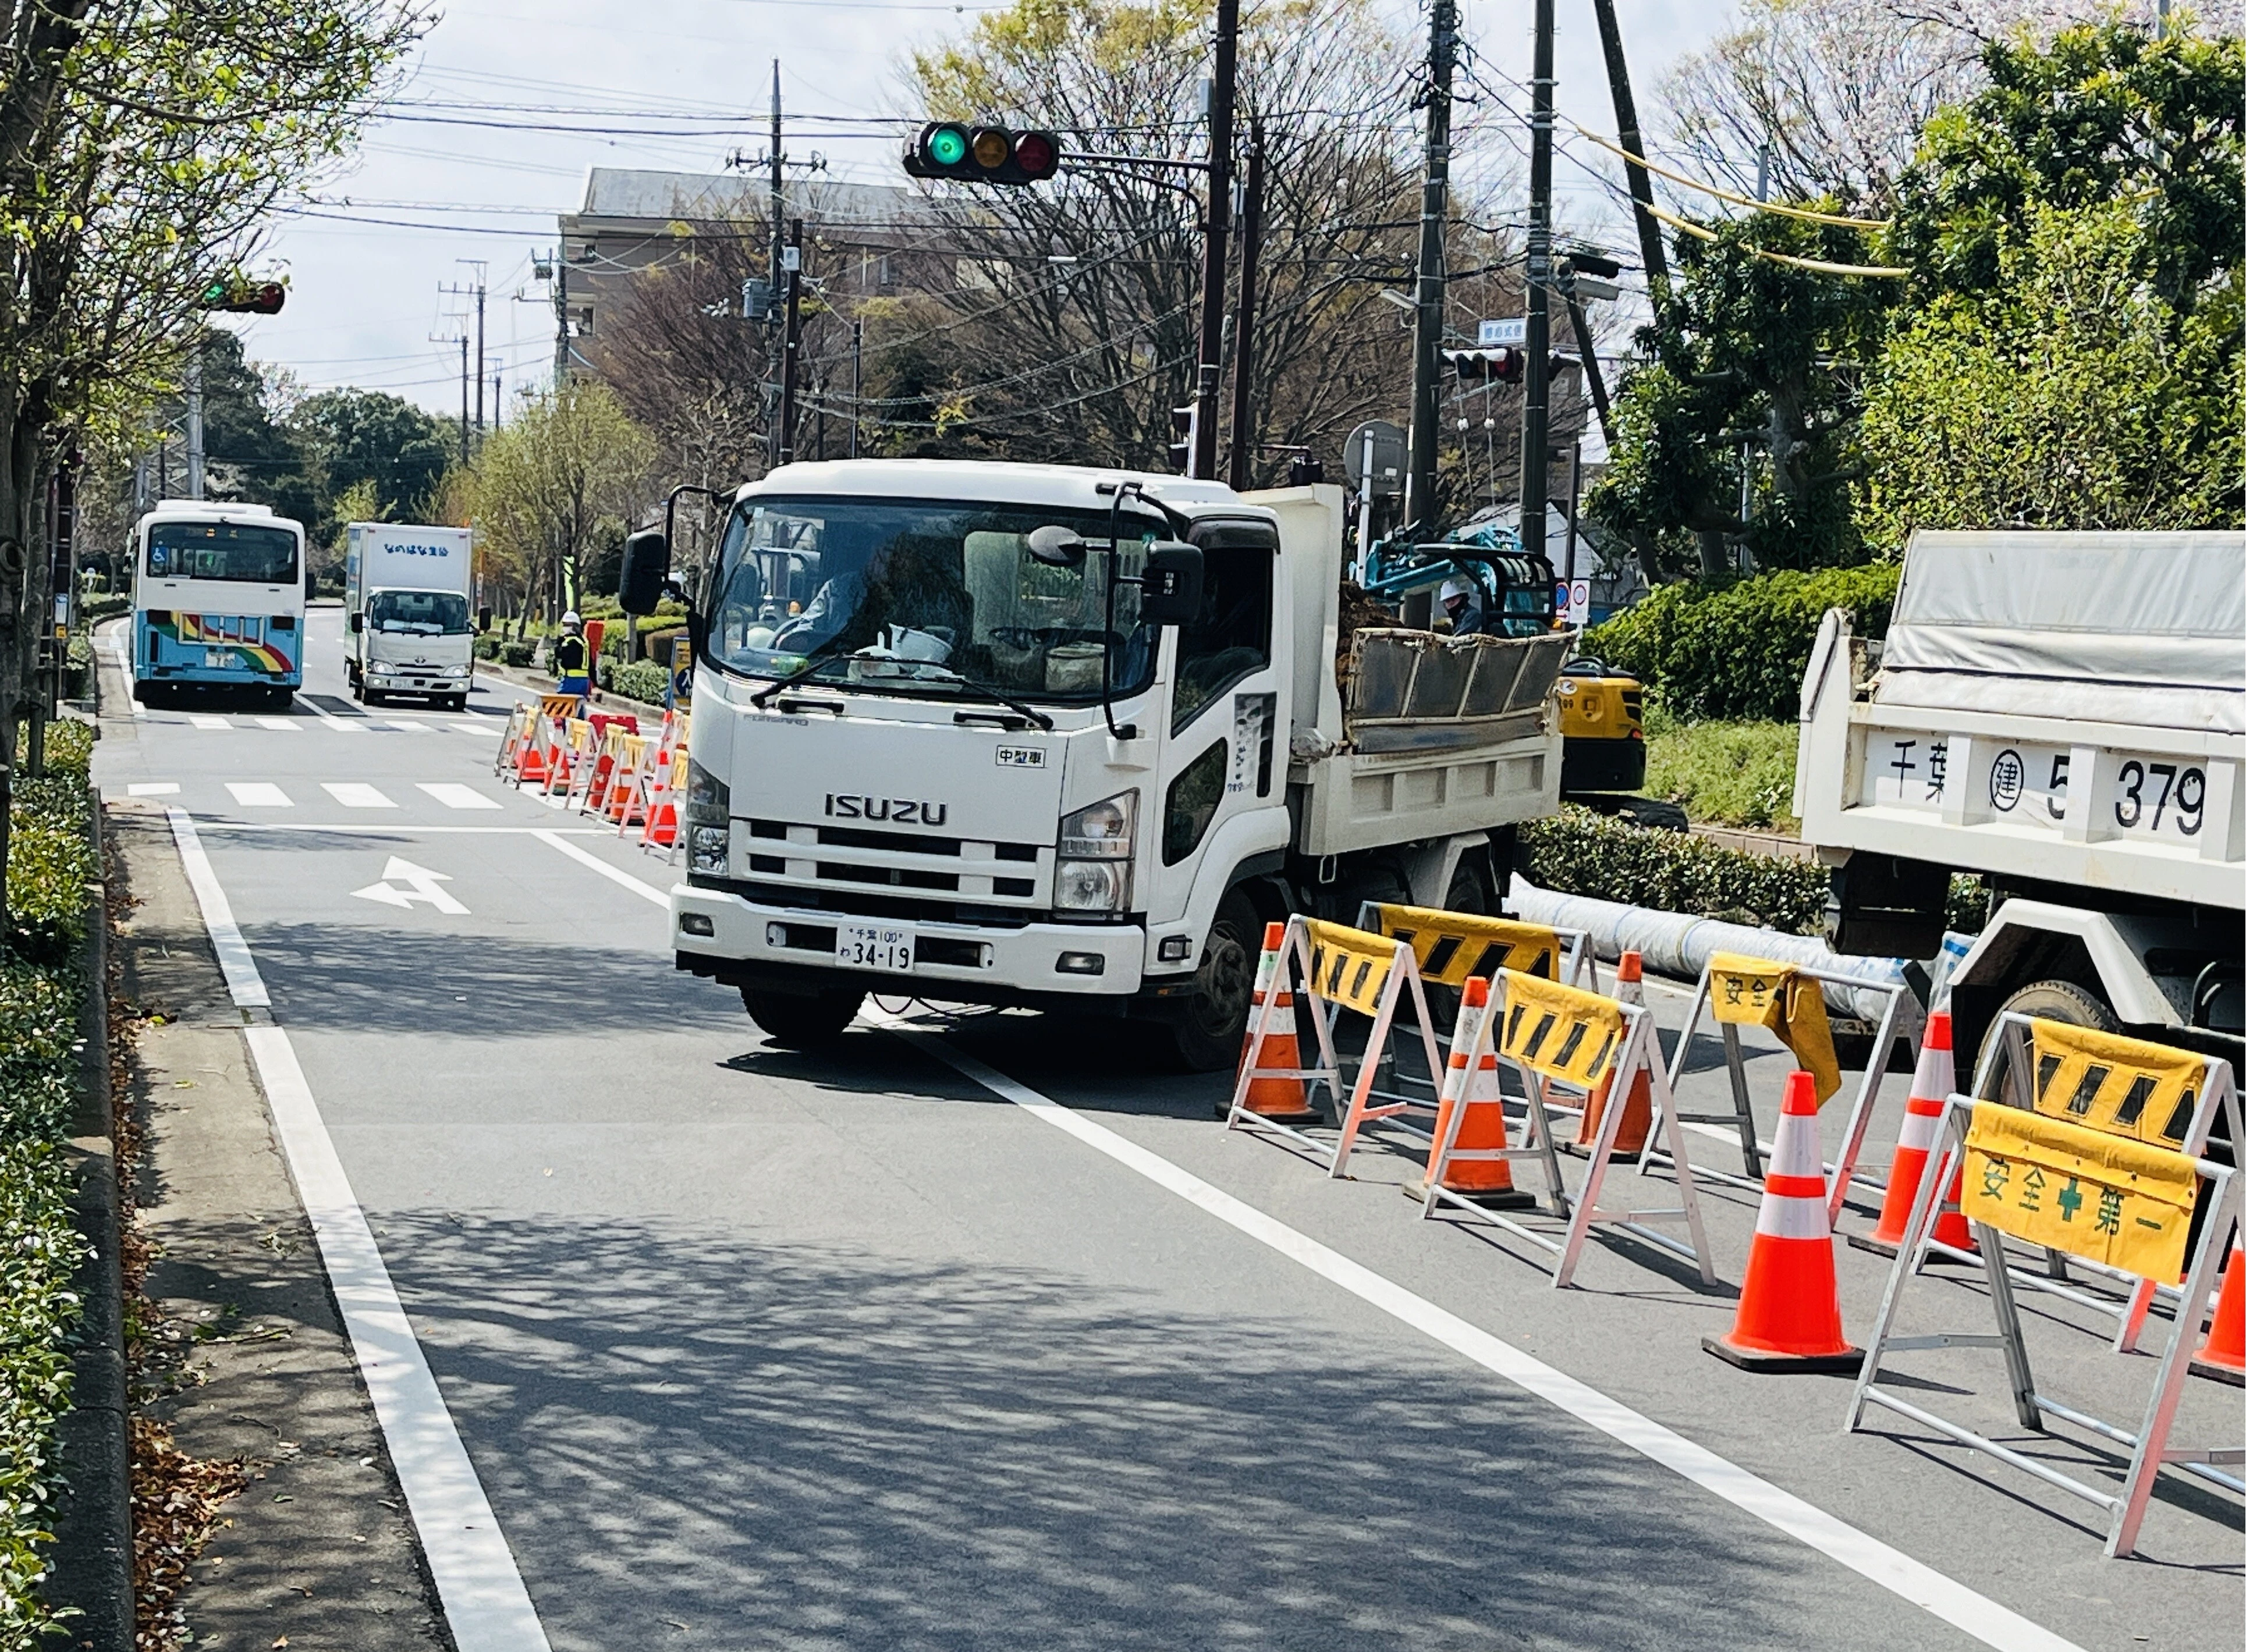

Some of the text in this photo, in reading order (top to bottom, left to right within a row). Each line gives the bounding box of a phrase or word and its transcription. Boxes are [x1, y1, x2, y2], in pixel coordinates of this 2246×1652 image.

[1000, 749, 1042, 764] 中型車
[825, 791, 948, 826] ISUZU
[1726, 975, 1768, 1007] 安全
